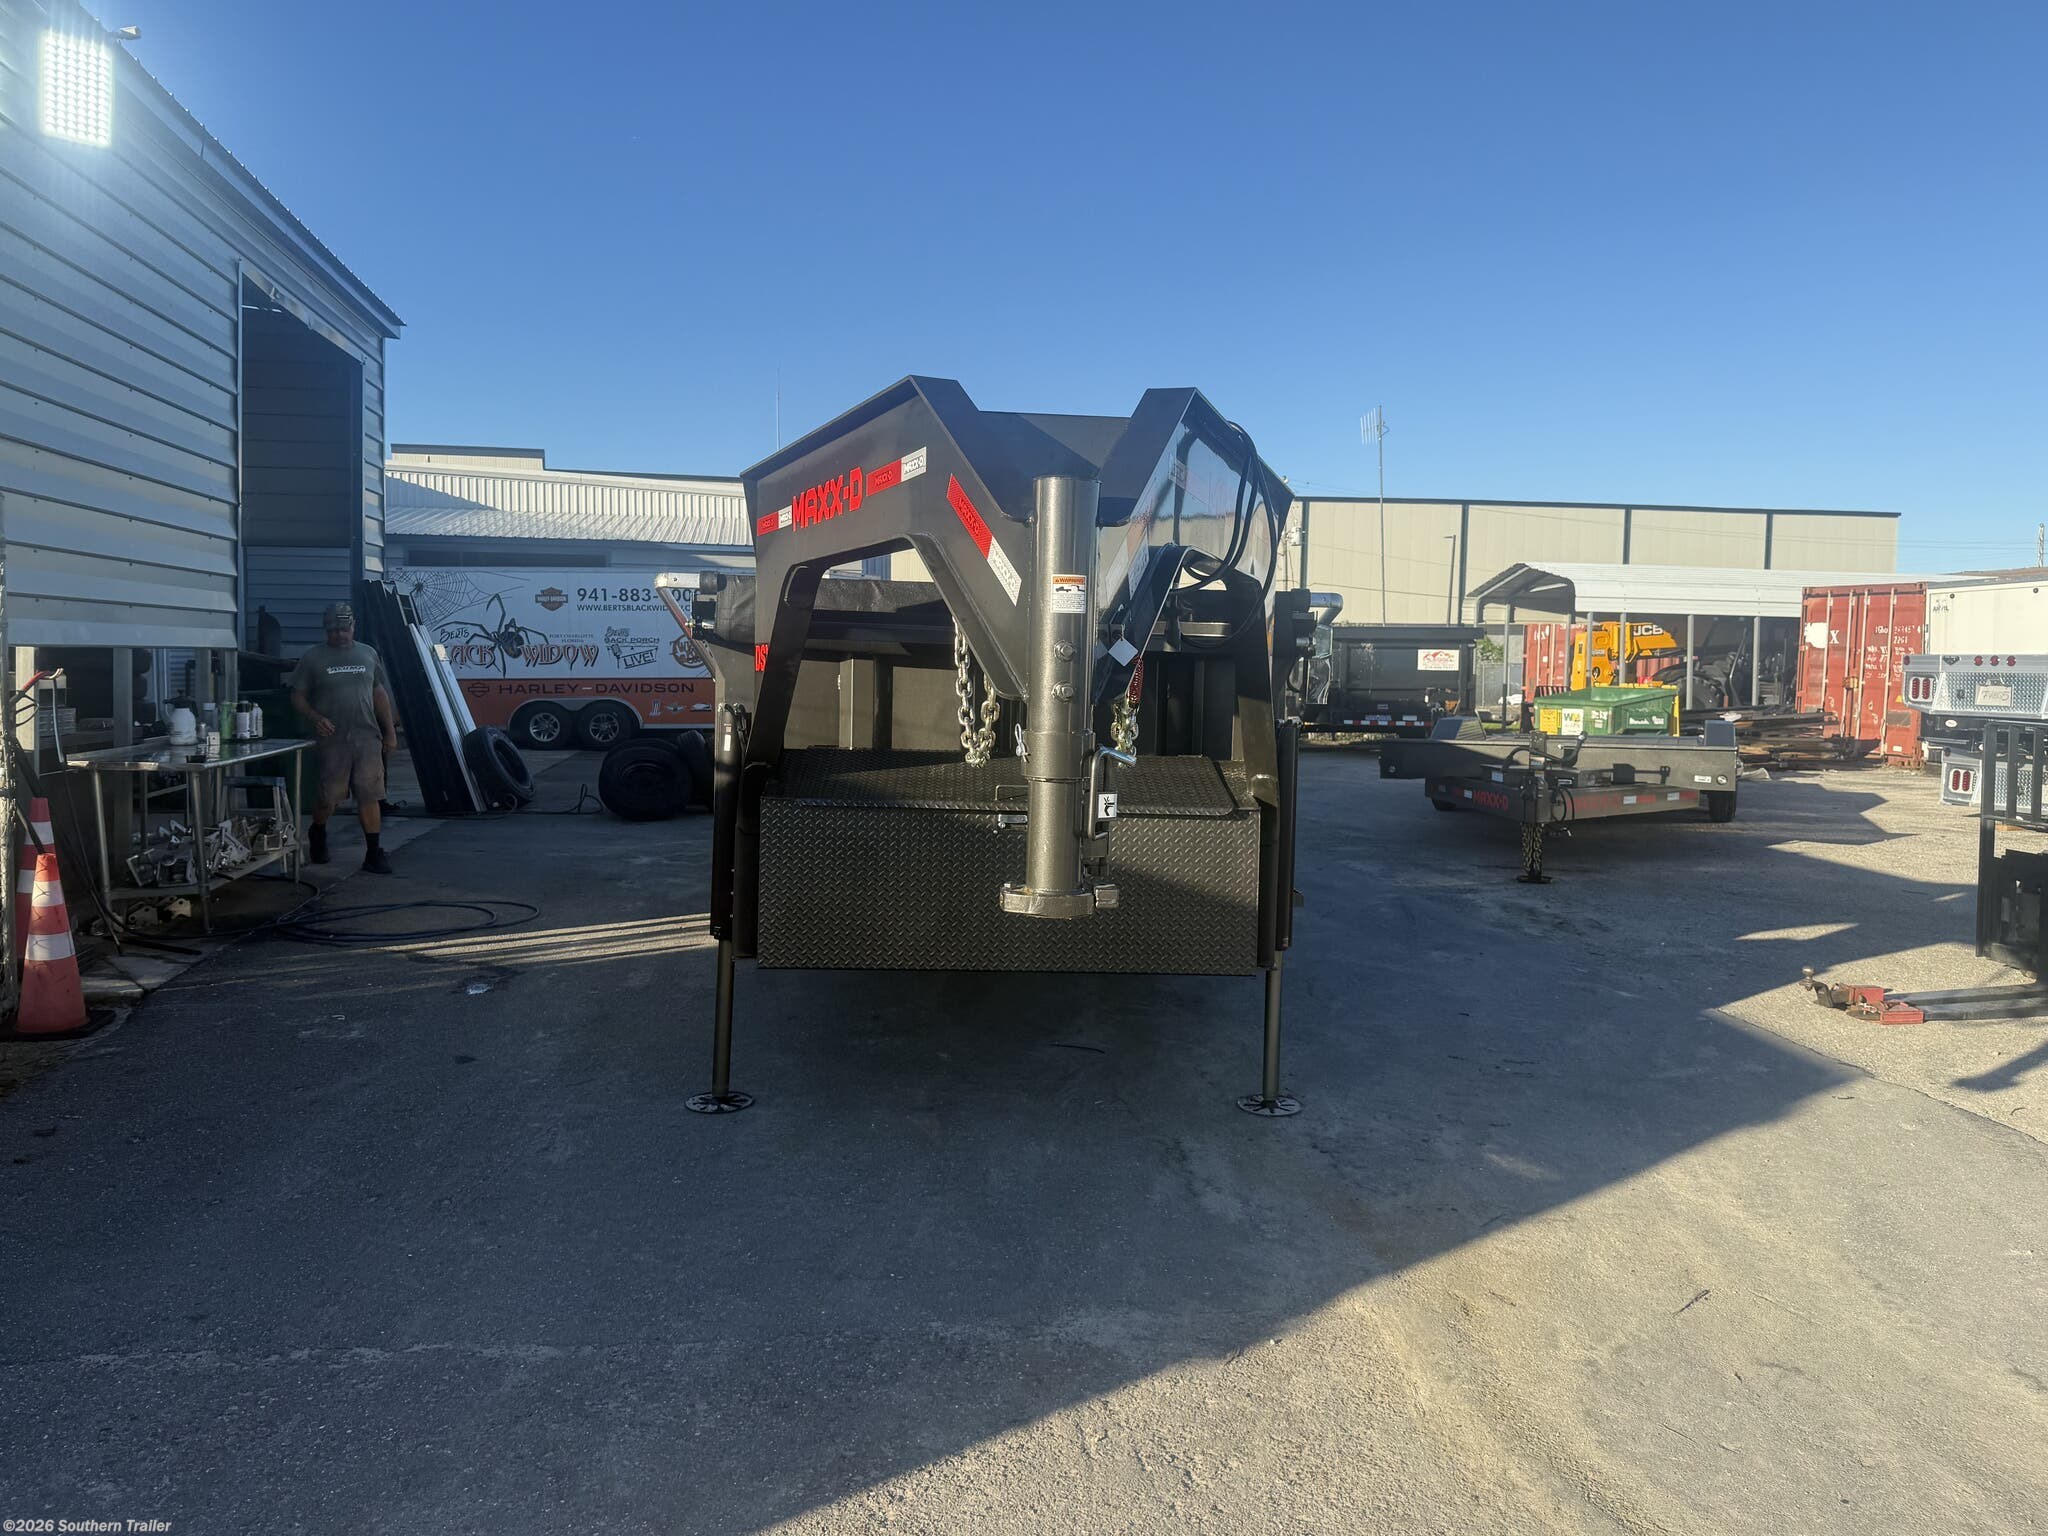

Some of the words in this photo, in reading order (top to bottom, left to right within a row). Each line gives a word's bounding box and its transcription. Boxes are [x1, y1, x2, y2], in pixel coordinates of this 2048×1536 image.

[792, 466, 863, 532] MAXX-D
[577, 587, 701, 602] 941-883-00
[1633, 624, 1664, 636] JCB
[519, 644, 600, 671] WIDOW
[623, 651, 655, 667] LIVE!
